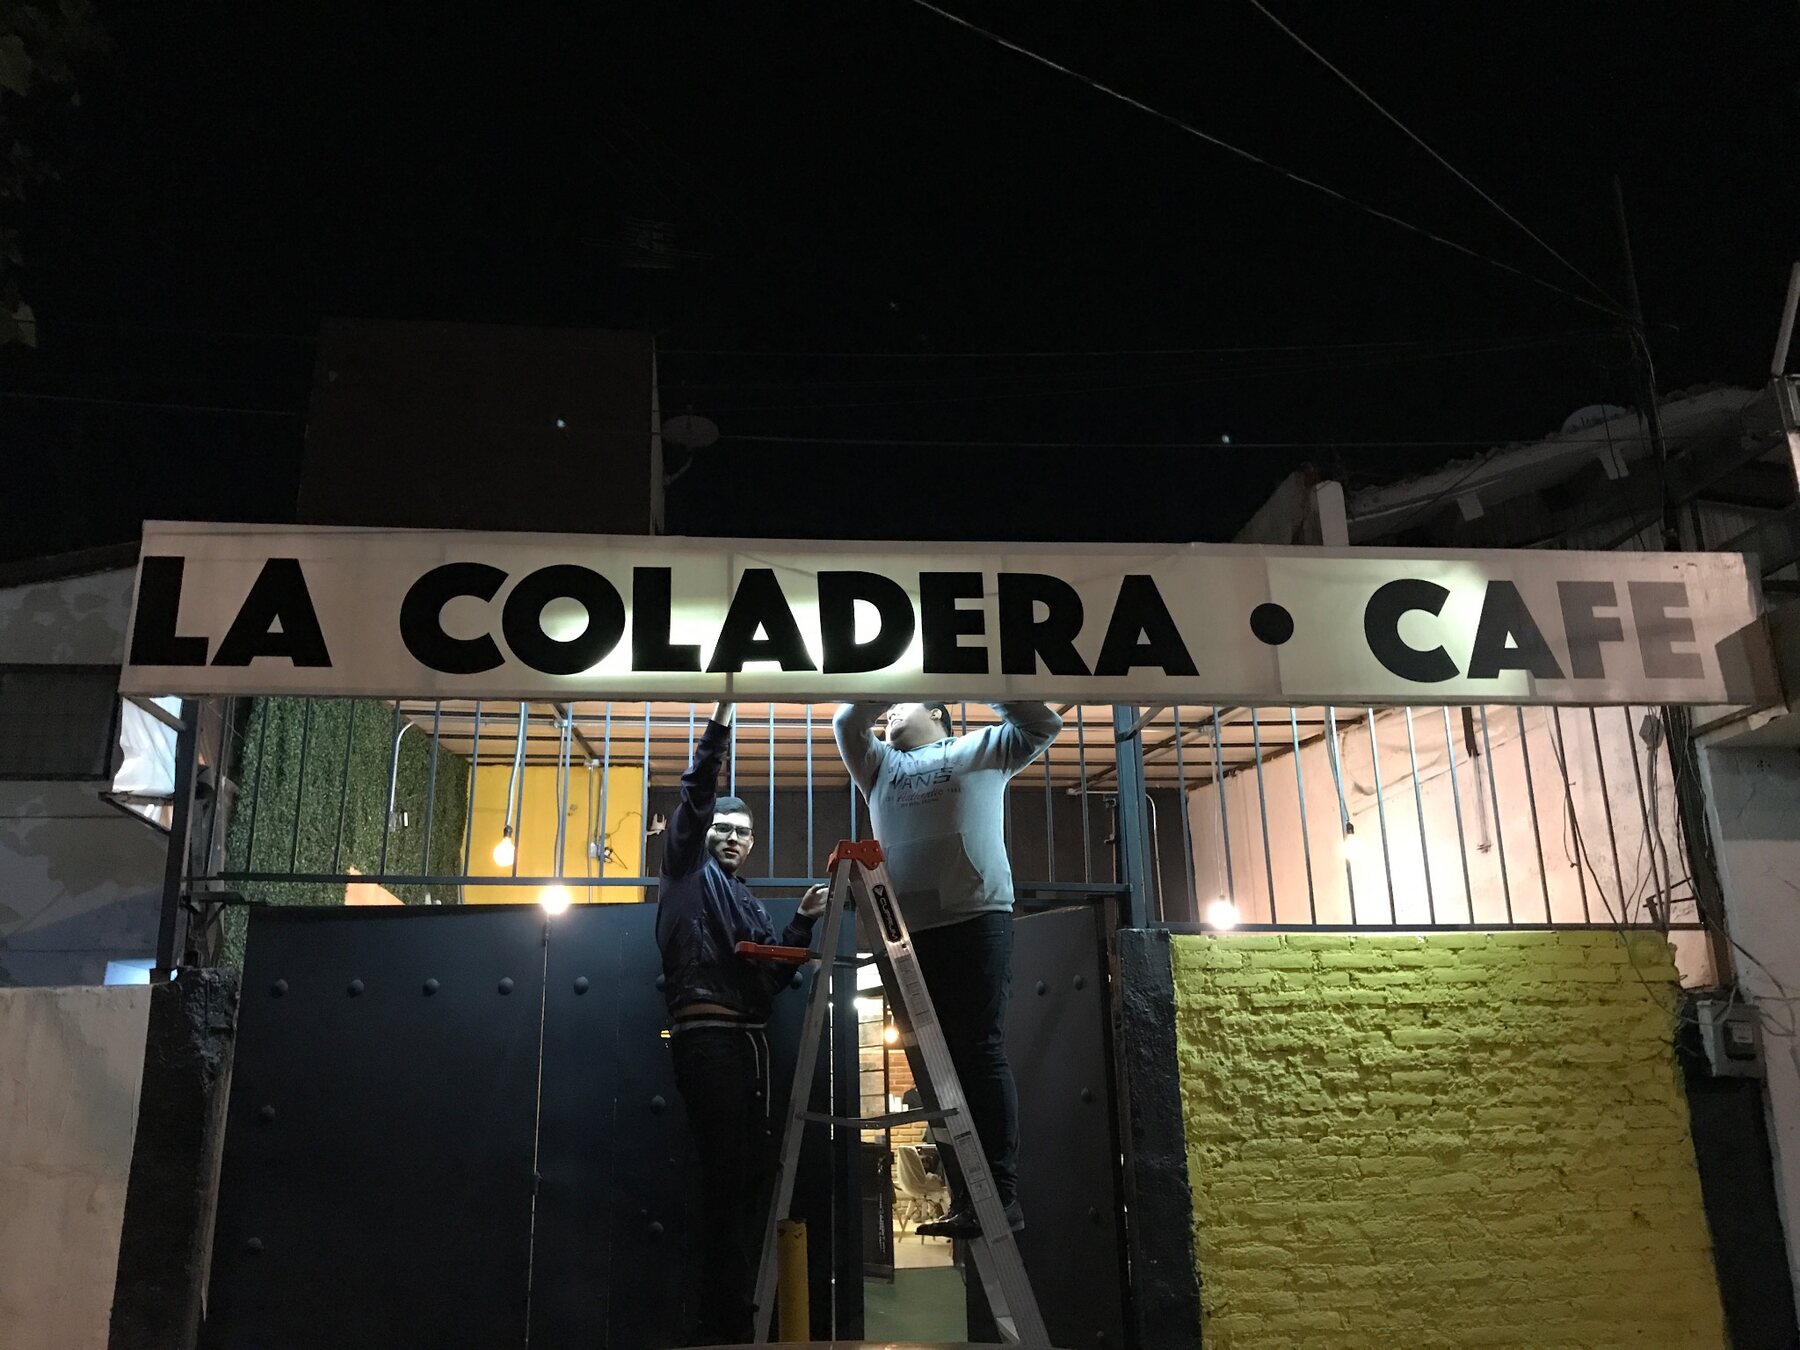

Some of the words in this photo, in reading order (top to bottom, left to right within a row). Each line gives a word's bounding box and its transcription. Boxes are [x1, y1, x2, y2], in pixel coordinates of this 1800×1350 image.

[130, 556, 332, 668] LA
[400, 561, 1200, 677] COLADERA
[1364, 578, 1705, 683] CAFE
[890, 767, 954, 789] VANS
